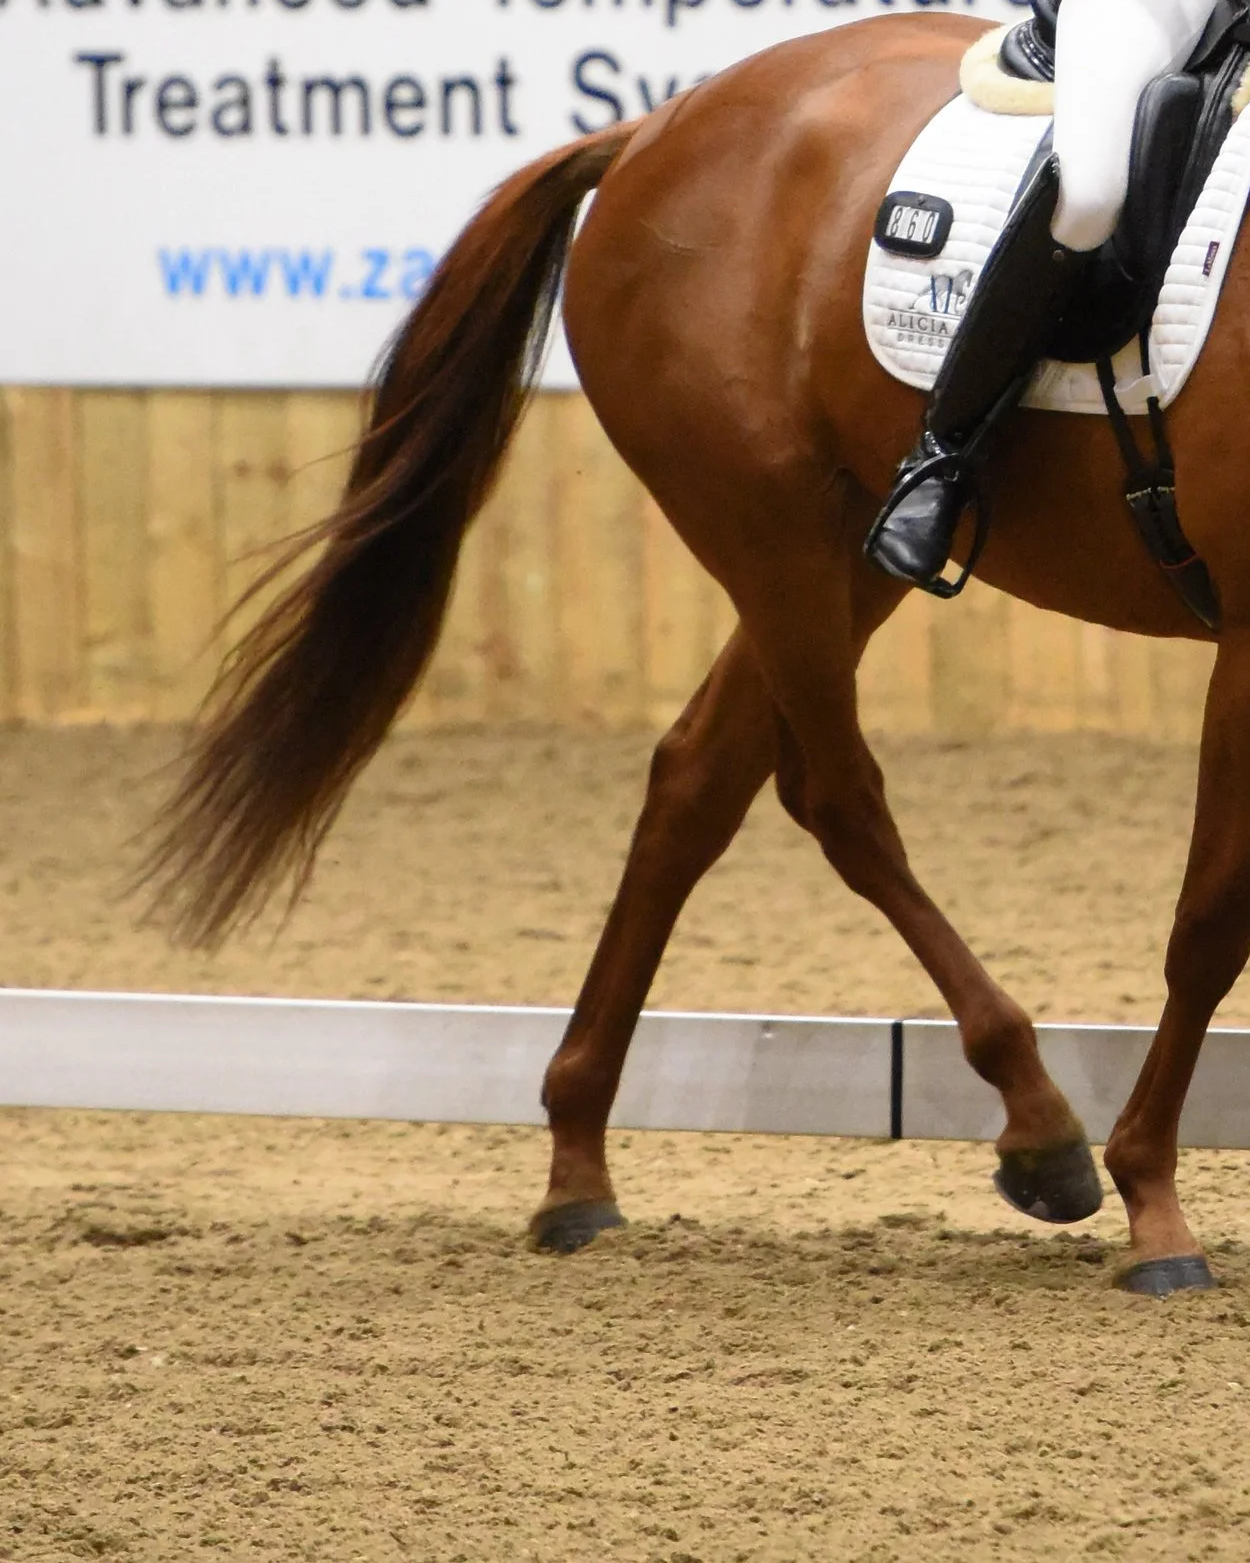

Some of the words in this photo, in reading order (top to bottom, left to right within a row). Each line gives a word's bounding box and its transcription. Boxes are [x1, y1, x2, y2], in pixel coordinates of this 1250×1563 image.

[74, 50, 517, 137] Treatment
[891, 207, 936, 242] 860
[888, 312, 949, 335] ALICIA
